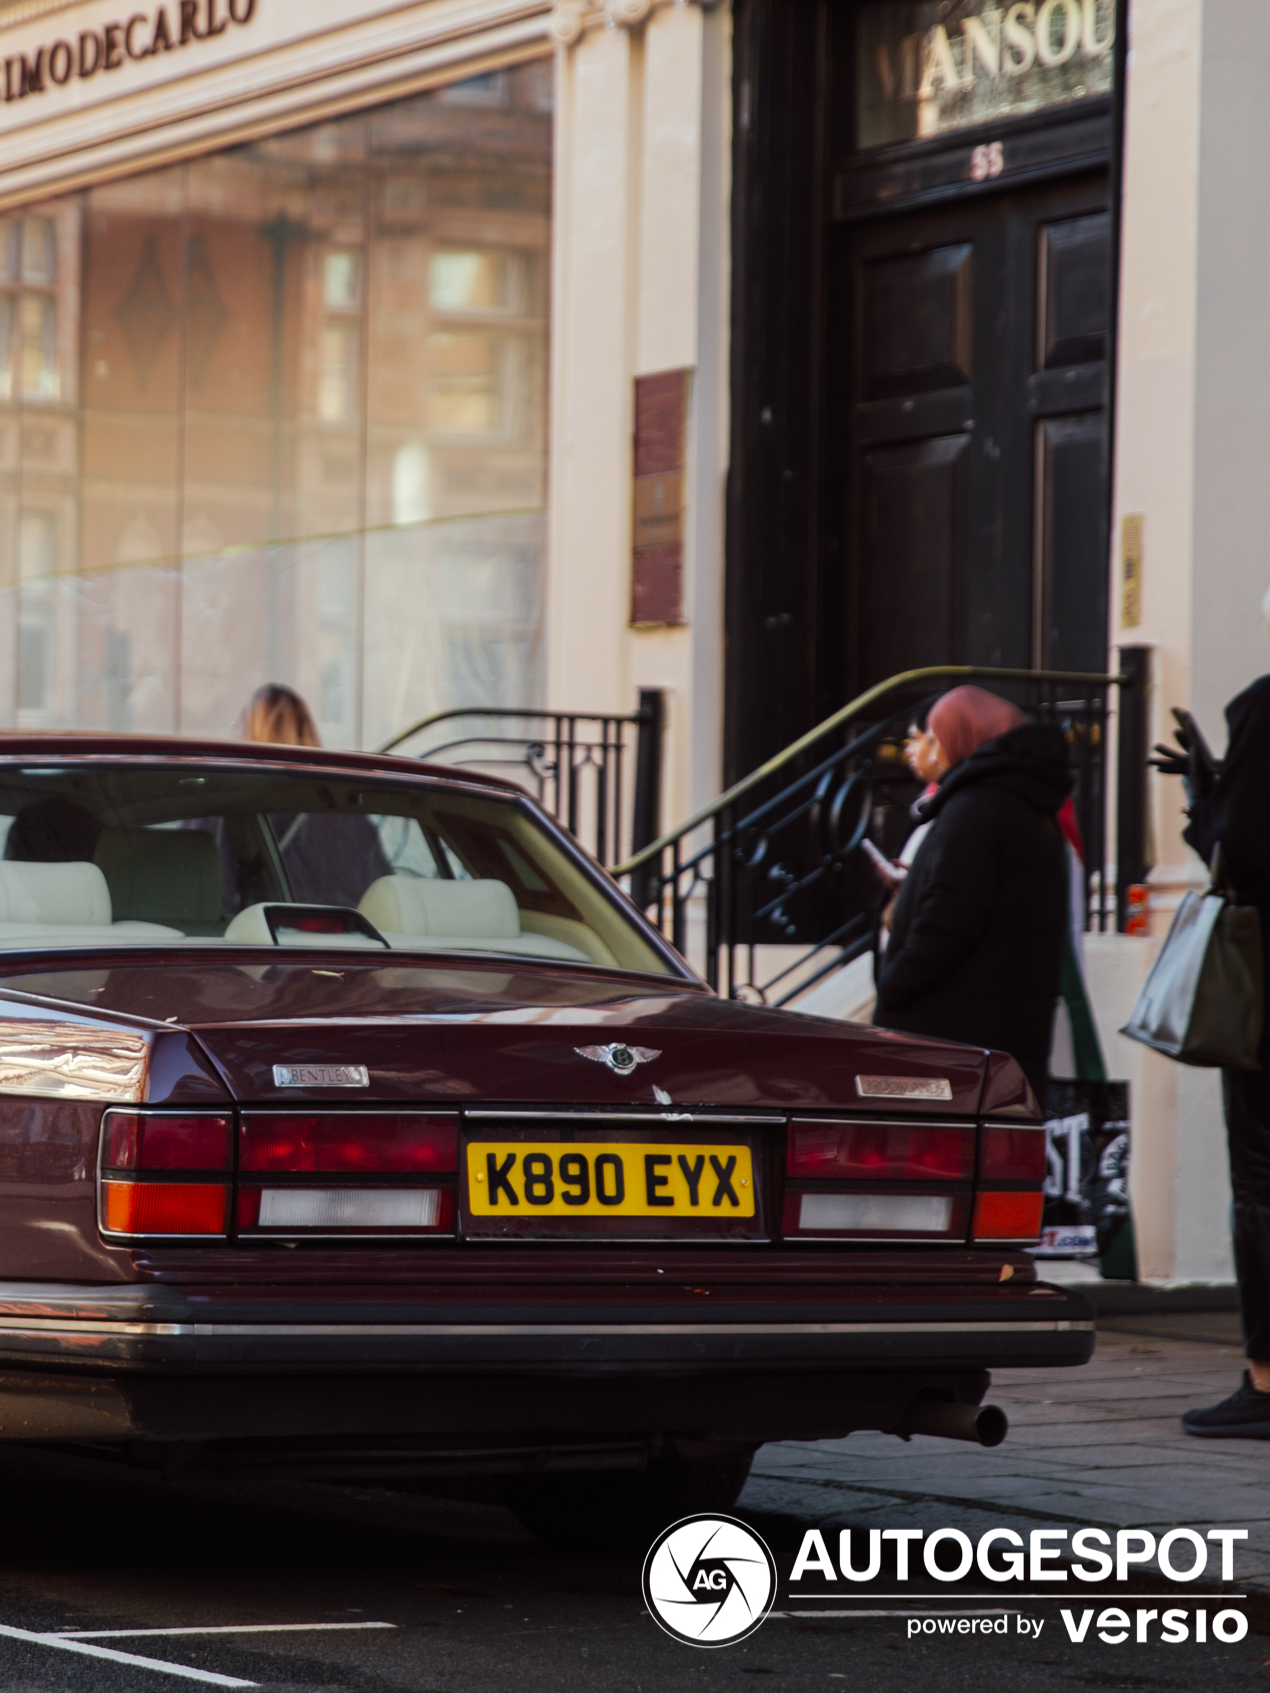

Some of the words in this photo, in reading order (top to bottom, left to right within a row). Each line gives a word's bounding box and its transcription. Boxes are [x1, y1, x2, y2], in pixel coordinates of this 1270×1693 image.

[291, 1069, 351, 1082] BENTLEY
[486, 1153, 625, 1205] K890
[644, 1154, 740, 1206] EYX
